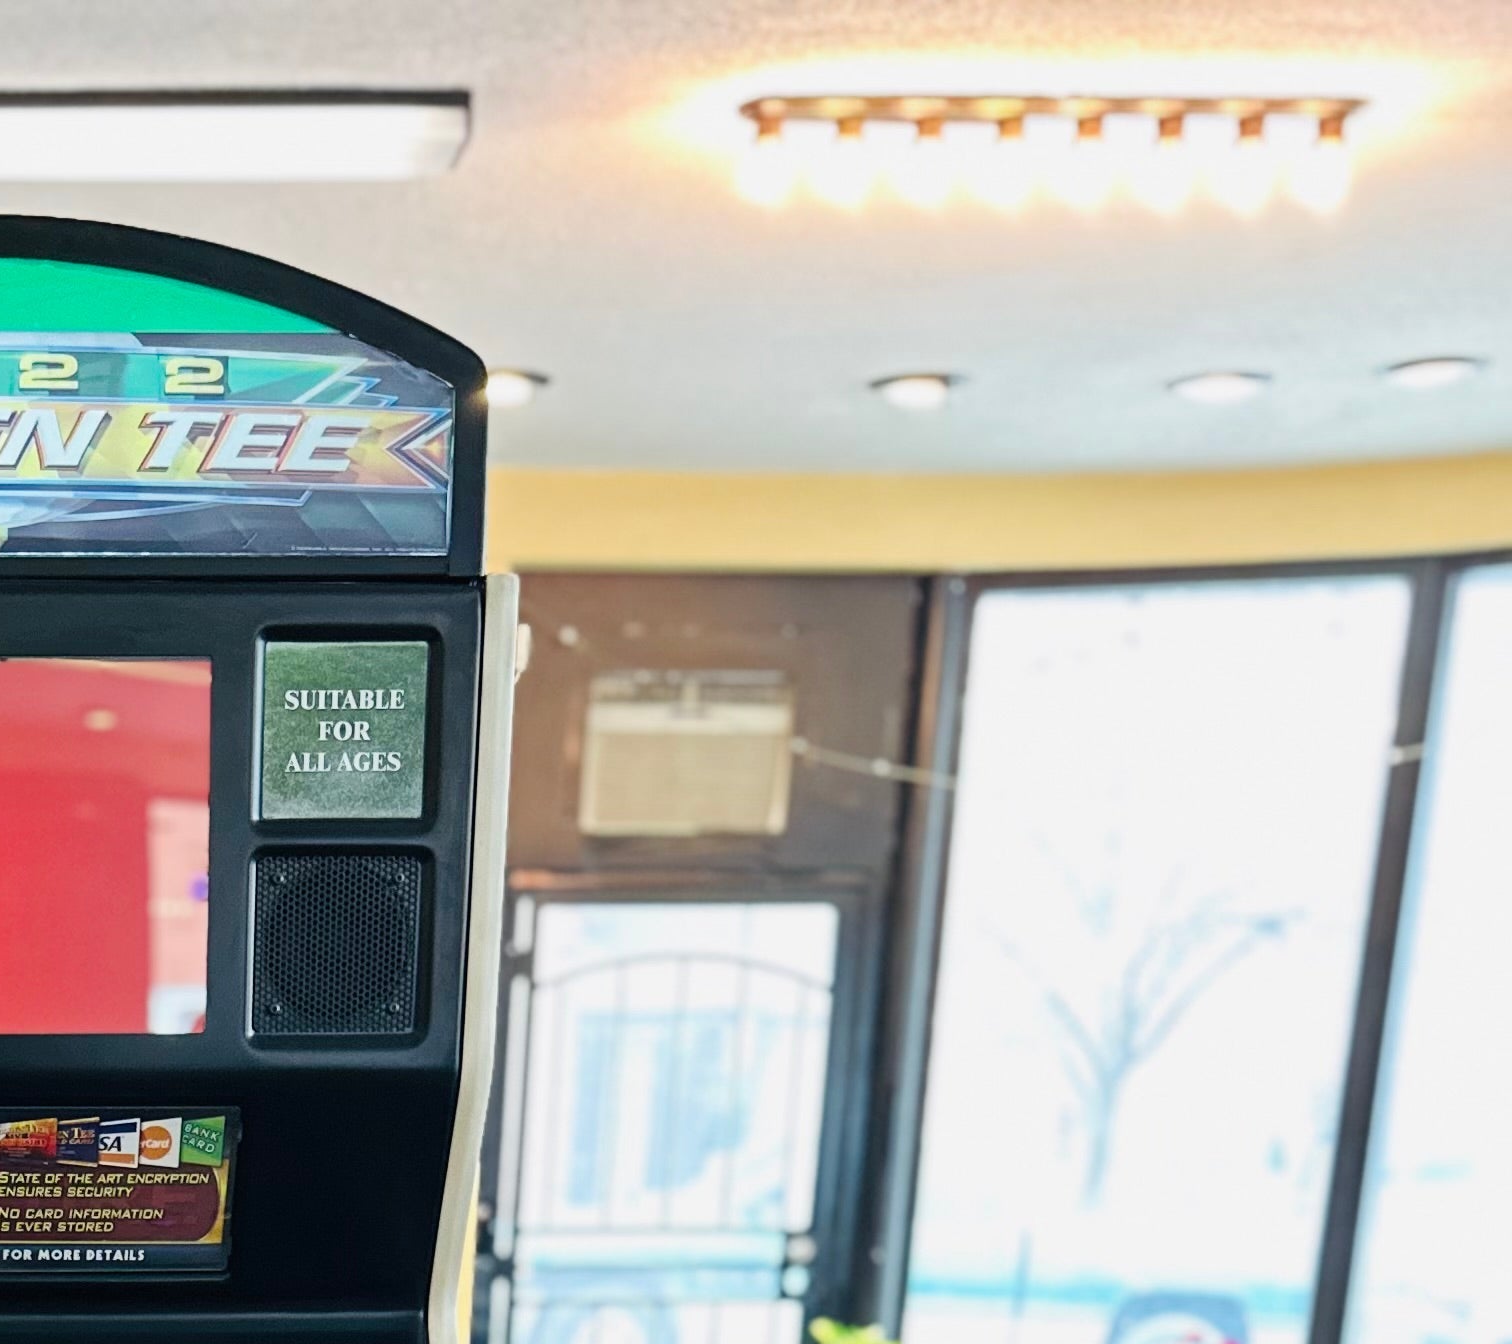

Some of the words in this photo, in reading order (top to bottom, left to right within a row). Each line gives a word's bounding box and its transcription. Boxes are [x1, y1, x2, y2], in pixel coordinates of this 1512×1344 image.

[138, 409, 372, 474] TEE
[284, 689, 405, 711] SUITABLE
[318, 721, 371, 741] FOR
[285, 752, 331, 773] ALL
[336, 751, 402, 772] AGES
[183, 1123, 220, 1142] BANK
[182, 1135, 215, 1154] CARD
[44, 1173, 61, 1184] OF
[67, 1173, 92, 1184] THE
[97, 1173, 122, 1184] ART
[127, 1173, 209, 1185] ENCRYPTION
[67, 1187, 134, 1198] SECURITY
[25, 1208, 64, 1219] CARD
[68, 1208, 164, 1219] INFORMATION
[15, 1221, 52, 1232] EVER
[57, 1221, 114, 1232] STORED
[2, 1248, 33, 1261] FOR
[38, 1248, 81, 1261] MORE
[86, 1248, 145, 1261] DETAILS
